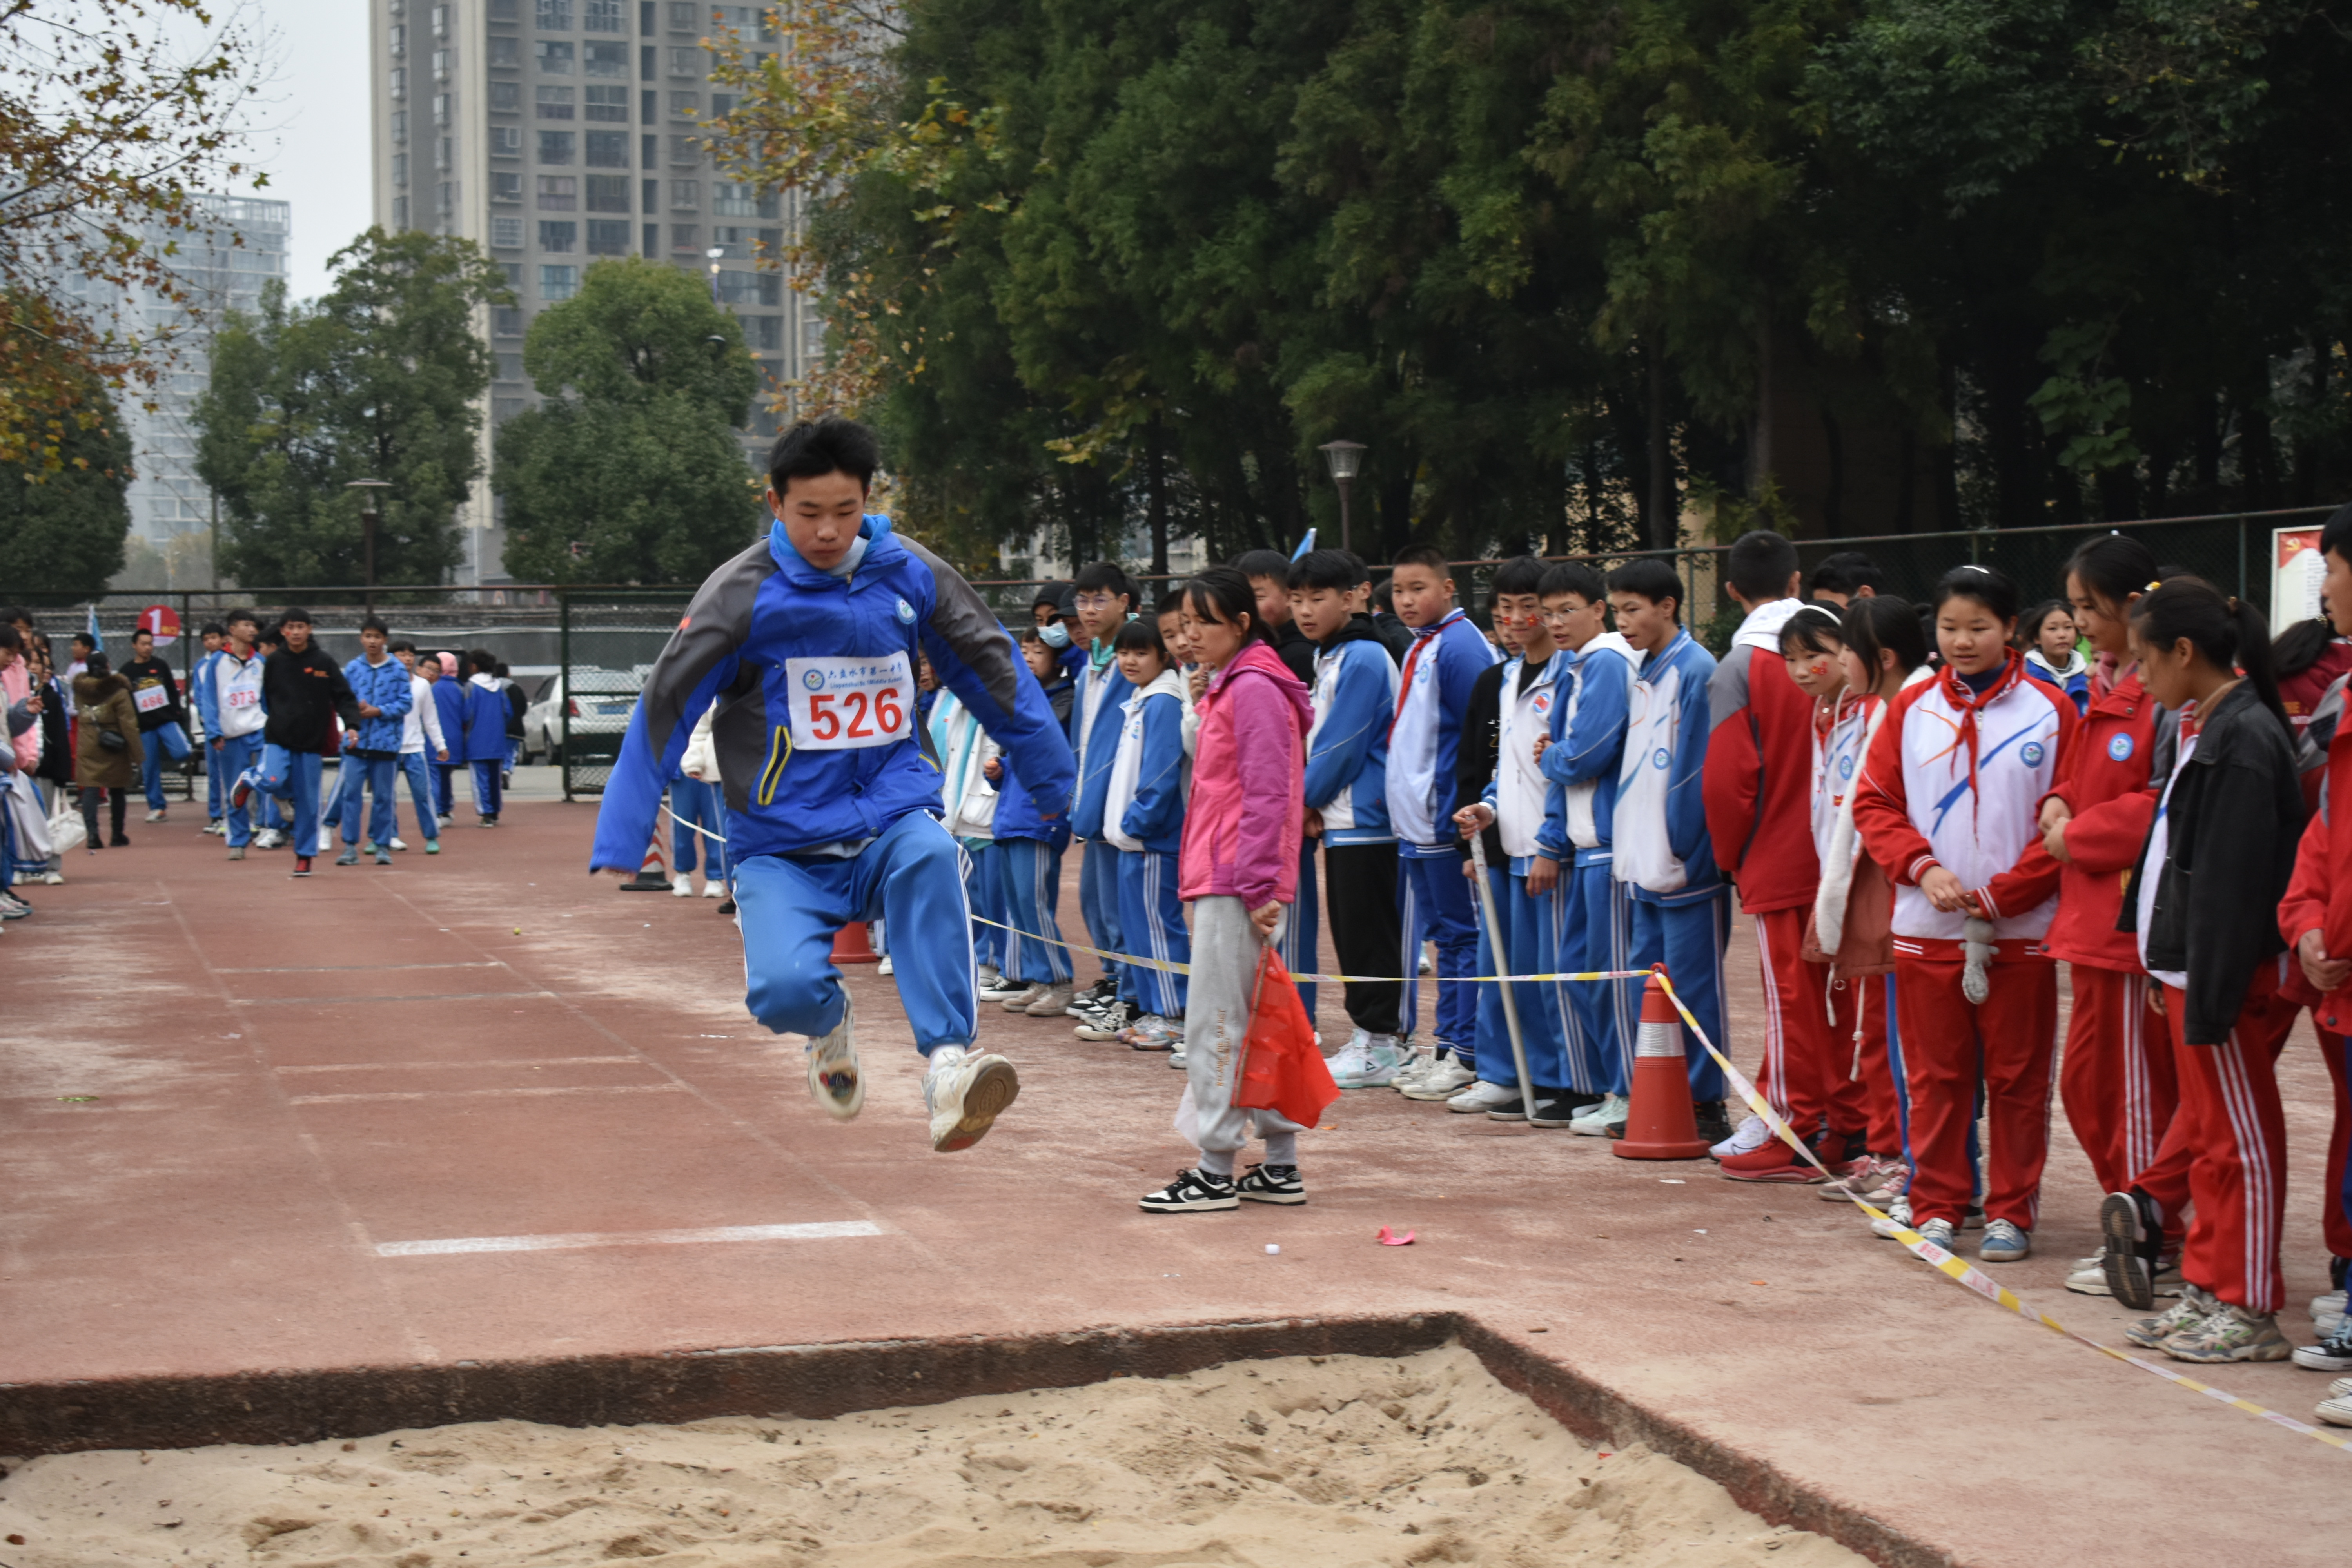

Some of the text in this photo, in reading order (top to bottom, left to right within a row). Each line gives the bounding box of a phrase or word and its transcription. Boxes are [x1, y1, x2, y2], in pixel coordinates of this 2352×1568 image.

[149, 609, 162, 635] 1
[230, 690, 256, 706] 373
[810, 688, 902, 740] 526
